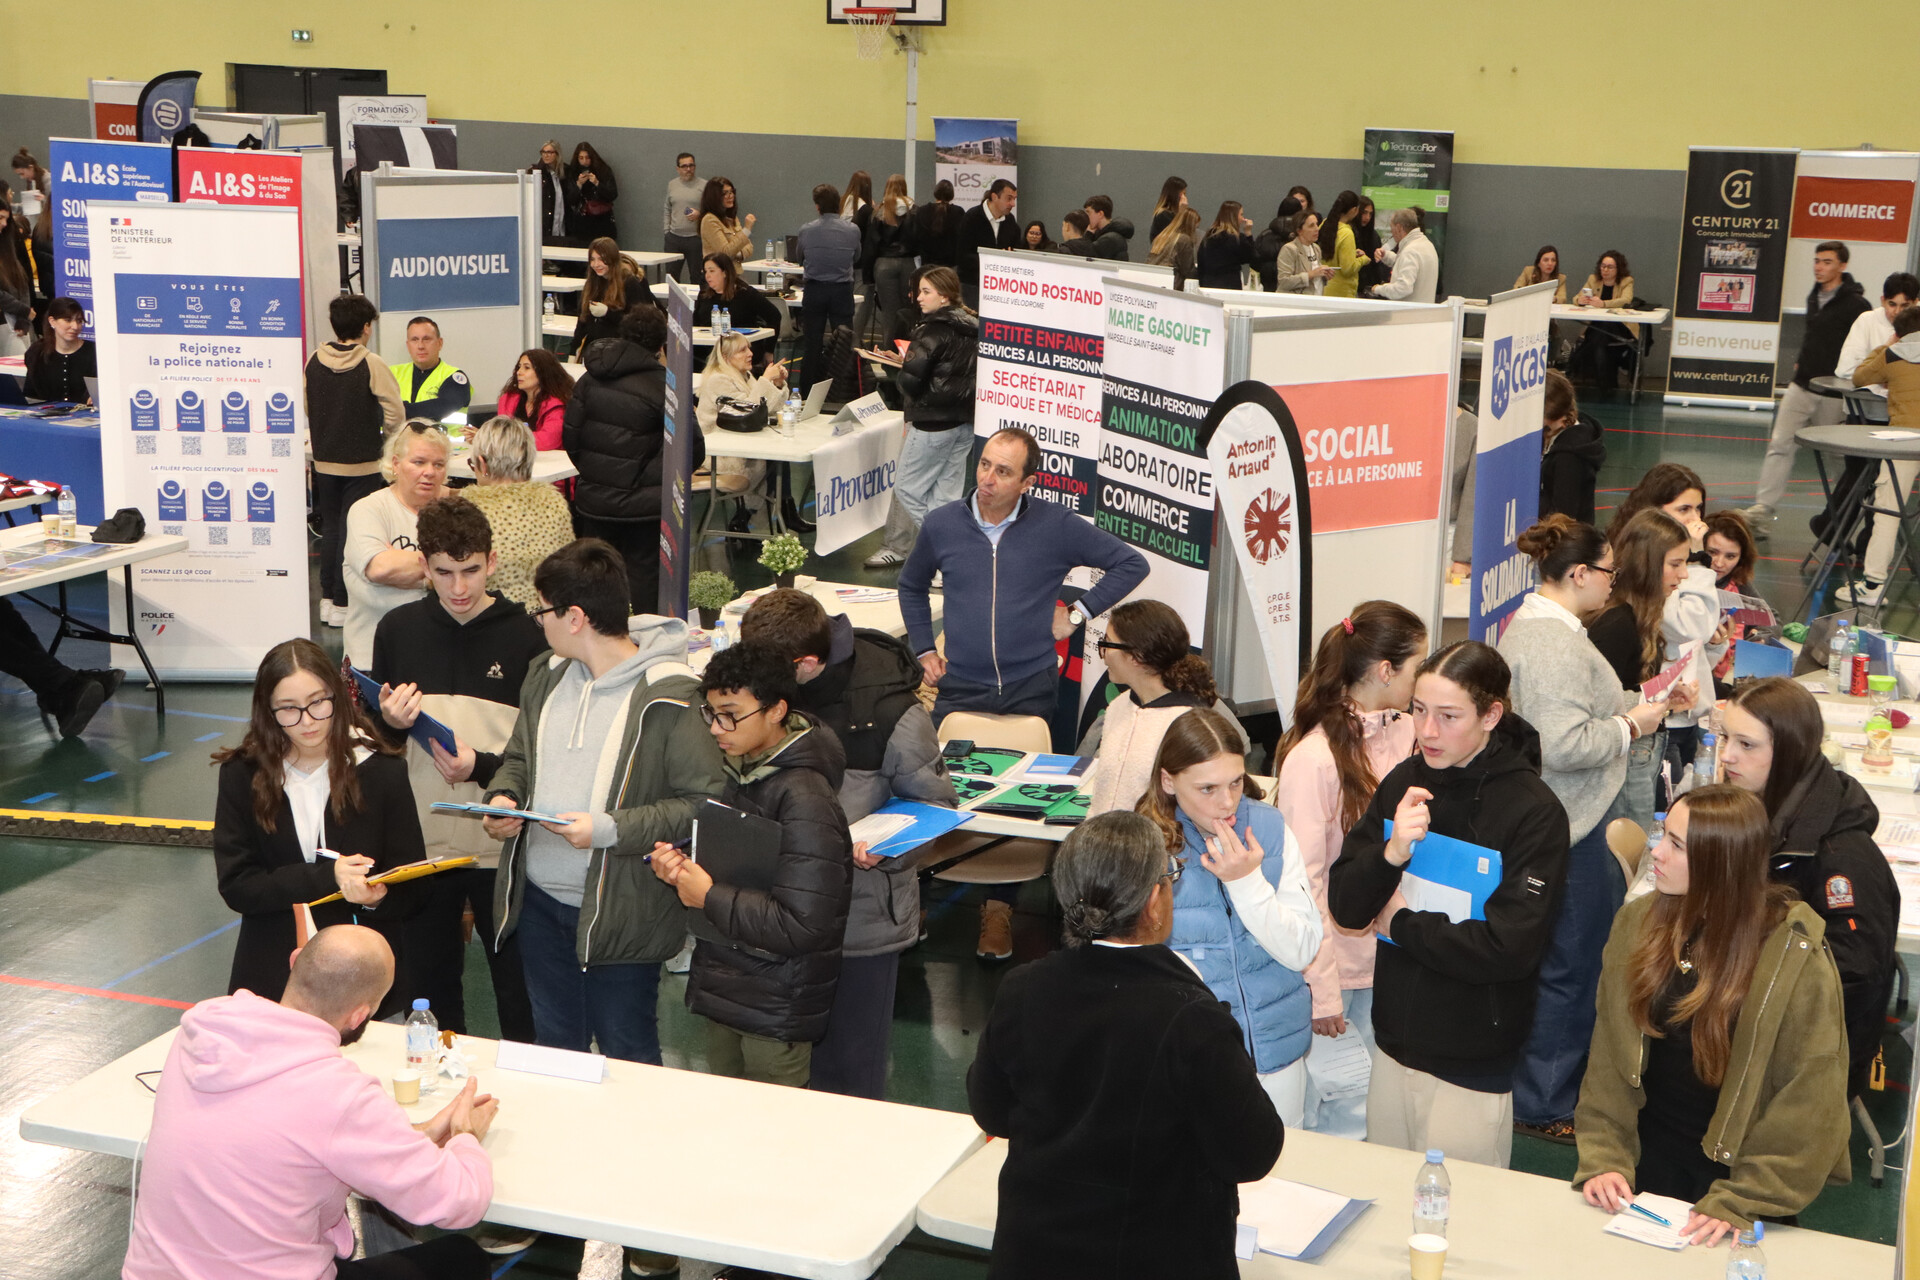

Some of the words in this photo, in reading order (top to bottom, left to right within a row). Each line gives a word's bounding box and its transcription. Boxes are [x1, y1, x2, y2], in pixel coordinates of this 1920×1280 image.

[357, 106, 409, 114] FORMATIONS
[1390, 141, 1438, 152] TechnicoFlor
[61, 161, 120, 186] A.I&S
[189, 170, 256, 198] A.I&S
[953, 168, 982, 188] ies
[1692, 216, 1762, 229] CENTURY
[1808, 202, 1896, 220] COMMERCE
[1696, 230, 1729, 238] Concept
[1730, 231, 1772, 239] Immobilier
[389, 254, 510, 278] AUDIOVISUEL
[171, 283, 205, 291] VOUS
[214, 283, 245, 292] ÊTES
[983, 275, 1038, 296] EDMOND
[1041, 283, 1103, 306] ROSTAND
[983, 294, 1009, 305] MARSEILLE
[1124, 295, 1158, 310] POLYVALENT
[1107, 332, 1133, 346] MARSEILLE
[1108, 307, 1145, 333] MARIE
[1148, 316, 1211, 347] GASQUET
[179, 343, 242, 356] Rejoignez
[985, 322, 1033, 345] PETITE
[1036, 327, 1104, 358] ENFANCE
[1677, 331, 1773, 352] Bienvenue
[149, 356, 160, 366] la
[164, 356, 202, 369] police
[205, 357, 264, 369] nationale
[268, 359, 272, 368] !
[978, 341, 1026, 361] SERVICES
[1027, 350, 1035, 363] A
[1037, 351, 1051, 366] LA
[1511, 344, 1546, 393] ccas
[1673, 368, 1770, 385] www.century21.fr
[992, 370, 1086, 400] SECRÉTARIAT
[976, 388, 1035, 411] JURIDIQUE
[1038, 400, 1053, 414] ET
[1141, 391, 1149, 405] A
[1150, 392, 1161, 409] LA
[1108, 405, 1196, 451] ANIMATION
[1226, 434, 1277, 459] Antonin
[1304, 423, 1394, 463] SOCIAL
[1098, 443, 1212, 497] ABORATOIRE
[1228, 455, 1270, 480] Artaud
[1325, 465, 1335, 486] À
[1337, 467, 1354, 485] LA
[1356, 461, 1423, 483] PERSONNE
[1102, 484, 1190, 534] COMMERCE
[1504, 498, 1516, 547] LA
[1131, 522, 1147, 543] ET
[1148, 529, 1204, 564] ACCUEIL
